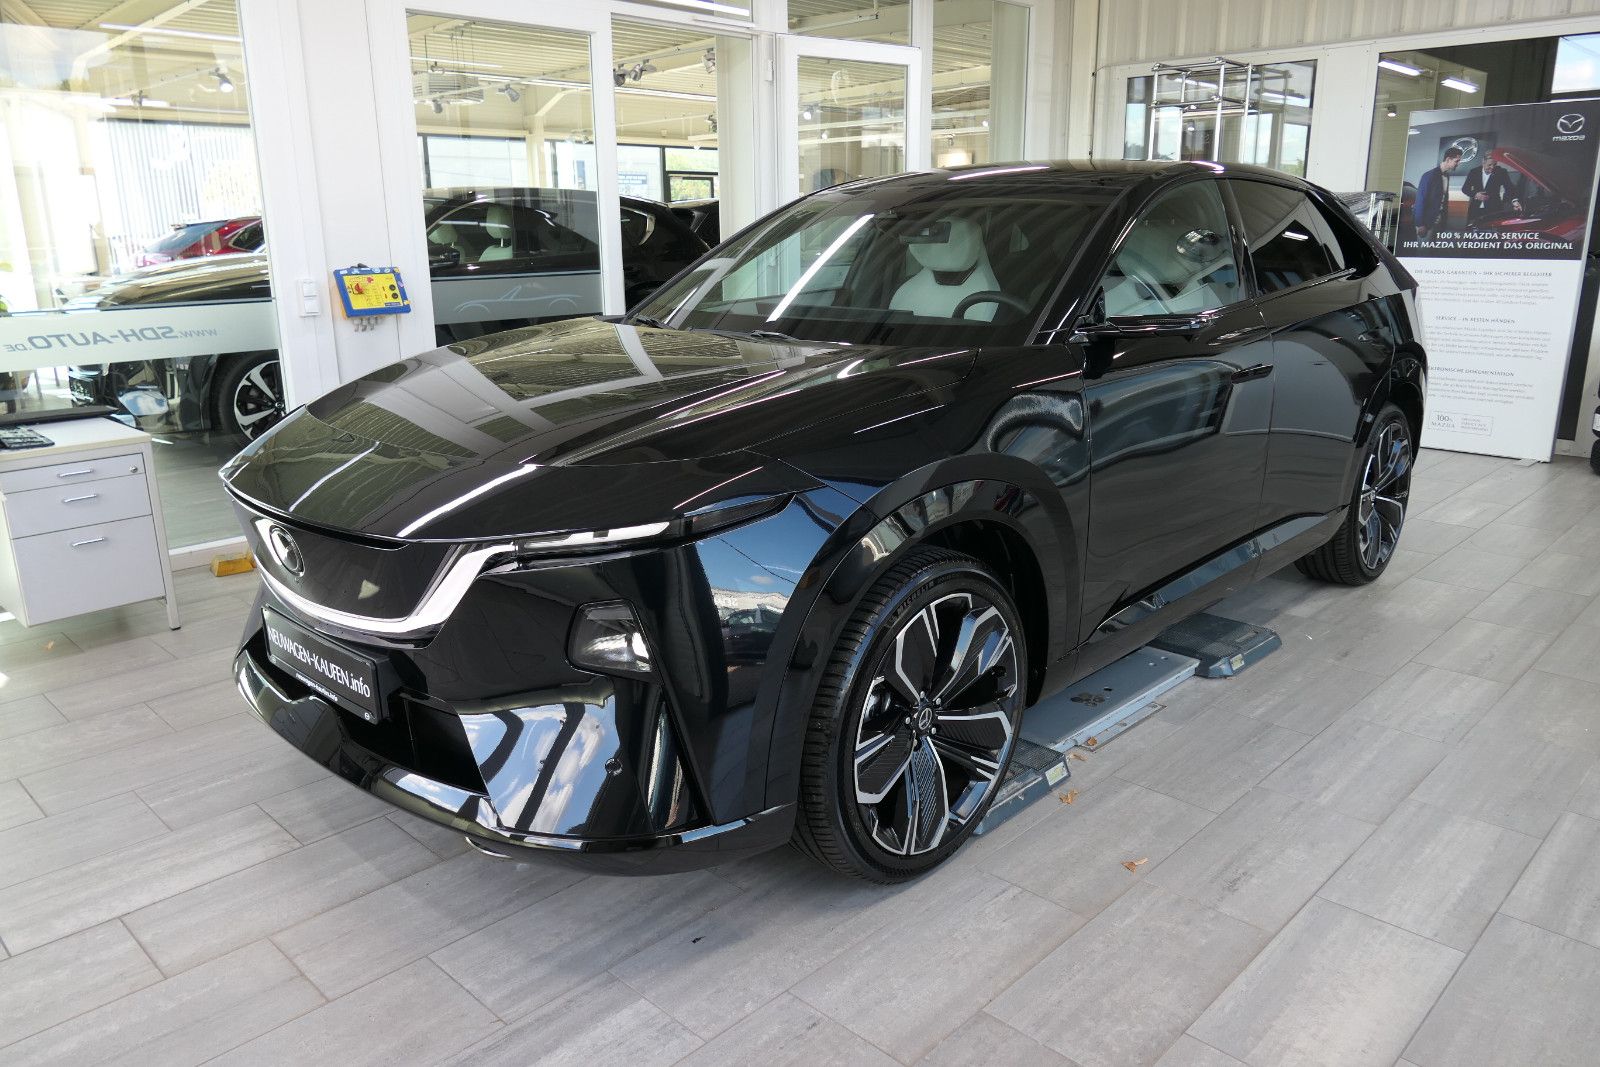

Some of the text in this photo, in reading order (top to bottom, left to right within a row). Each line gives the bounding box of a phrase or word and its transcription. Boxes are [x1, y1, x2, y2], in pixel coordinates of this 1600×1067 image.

[1463, 232, 1499, 240] MAZDA
[1501, 232, 1539, 240] SERVICE
[1421, 241, 1454, 249] MAZDA
[1456, 241, 1501, 249] VERDIENT
[1503, 241, 1523, 249] DAS
[1525, 242, 1573, 250] ORIGINAL
[267, 625, 371, 698] NEUWAGEN-KAUFEN.info
